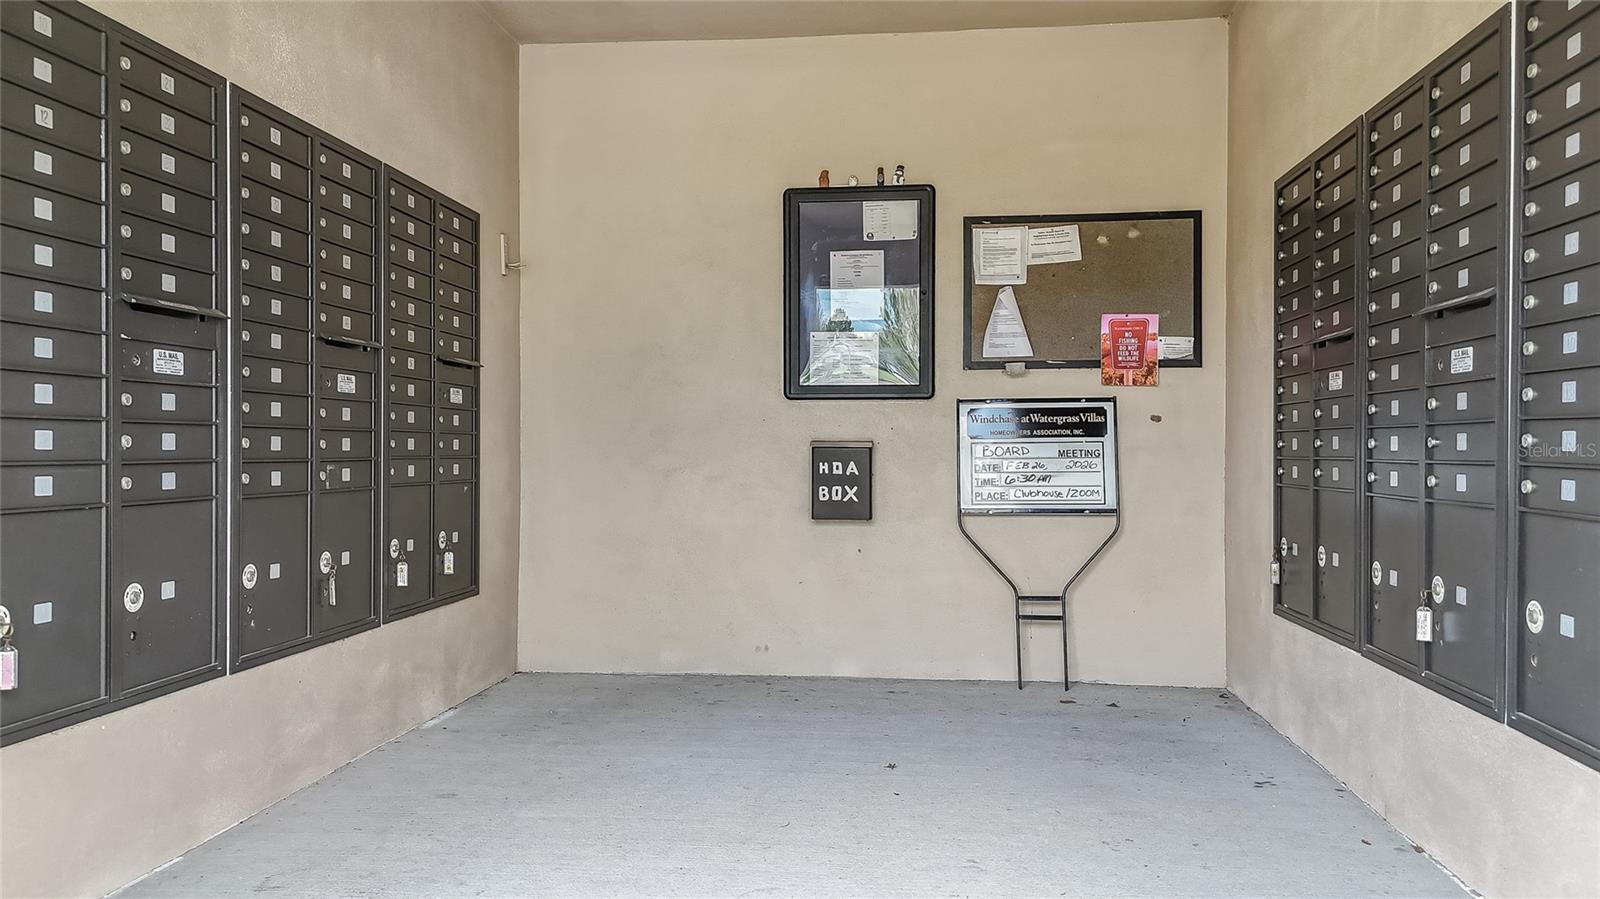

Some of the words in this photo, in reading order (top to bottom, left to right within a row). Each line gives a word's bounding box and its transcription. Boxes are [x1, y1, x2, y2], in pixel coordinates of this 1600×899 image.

[39, 109, 50, 125] 12
[1020, 415, 1031, 423] at
[1030, 412, 1081, 426] Watergrass
[1080, 412, 1106, 423] Villas
[983, 445, 1029, 457] BOARD
[1057, 449, 1101, 458] MEETING
[819, 461, 859, 475] HOA
[974, 463, 1001, 473] DATE:
[1005, 461, 1030, 470] FEB
[1065, 459, 1098, 470] 2026
[1004, 473, 1037, 485] 6:30
[819, 485, 859, 502] BOX
[974, 491, 1009, 501] PLACE:
